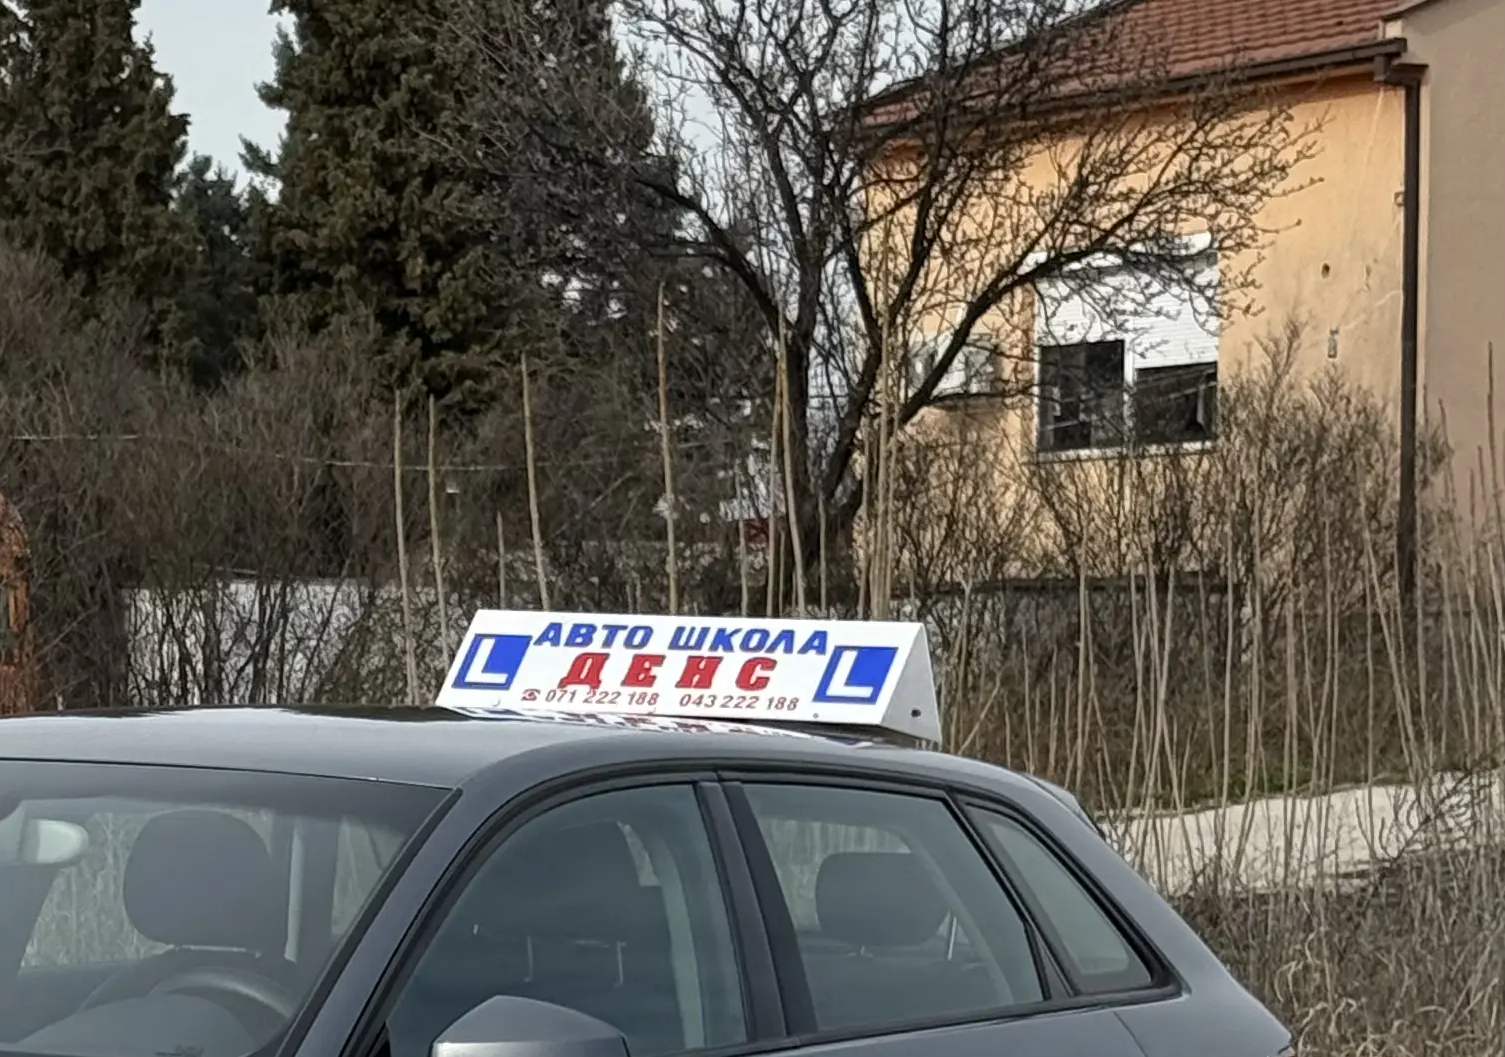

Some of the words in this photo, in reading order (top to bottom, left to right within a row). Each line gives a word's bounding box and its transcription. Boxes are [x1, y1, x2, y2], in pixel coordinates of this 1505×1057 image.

[532, 622, 653, 650] АВТО
[667, 626, 828, 656] ШКОЛА
[545, 689, 577, 703] 071
[583, 690, 620, 705] 222
[627, 692, 660, 706] 188
[679, 694, 715, 708] 043
[719, 695, 757, 709] 222
[765, 696, 799, 711] 188
